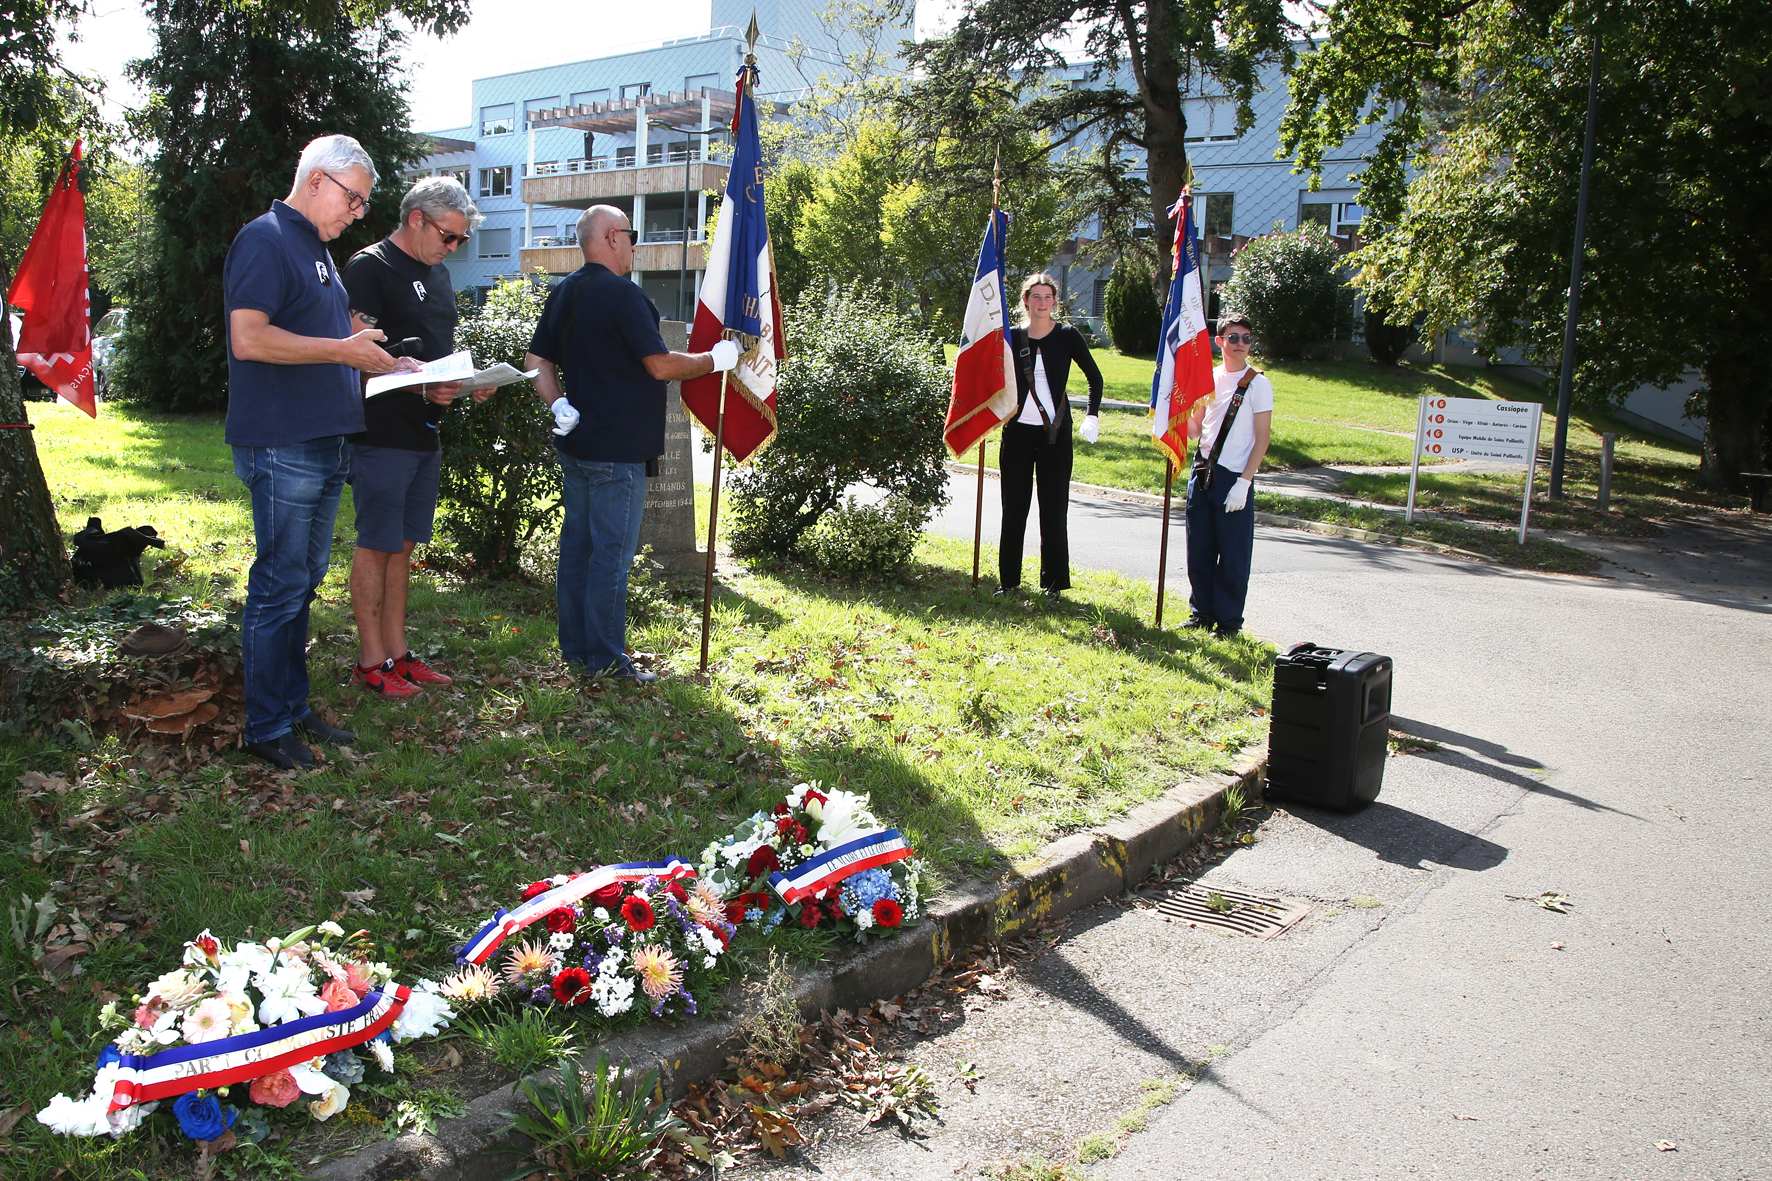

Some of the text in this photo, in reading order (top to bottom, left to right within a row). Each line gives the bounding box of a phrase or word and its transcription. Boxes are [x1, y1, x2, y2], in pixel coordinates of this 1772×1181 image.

[1496, 404, 1529, 414] Cassiopée
[646, 481, 686, 492] LLEMANDS
[643, 499, 677, 509] SEPTEMBRE
[826, 860, 839, 872] LE
[174, 1053, 230, 1080] PARTI
[245, 1019, 357, 1064] COMMUNISTE
